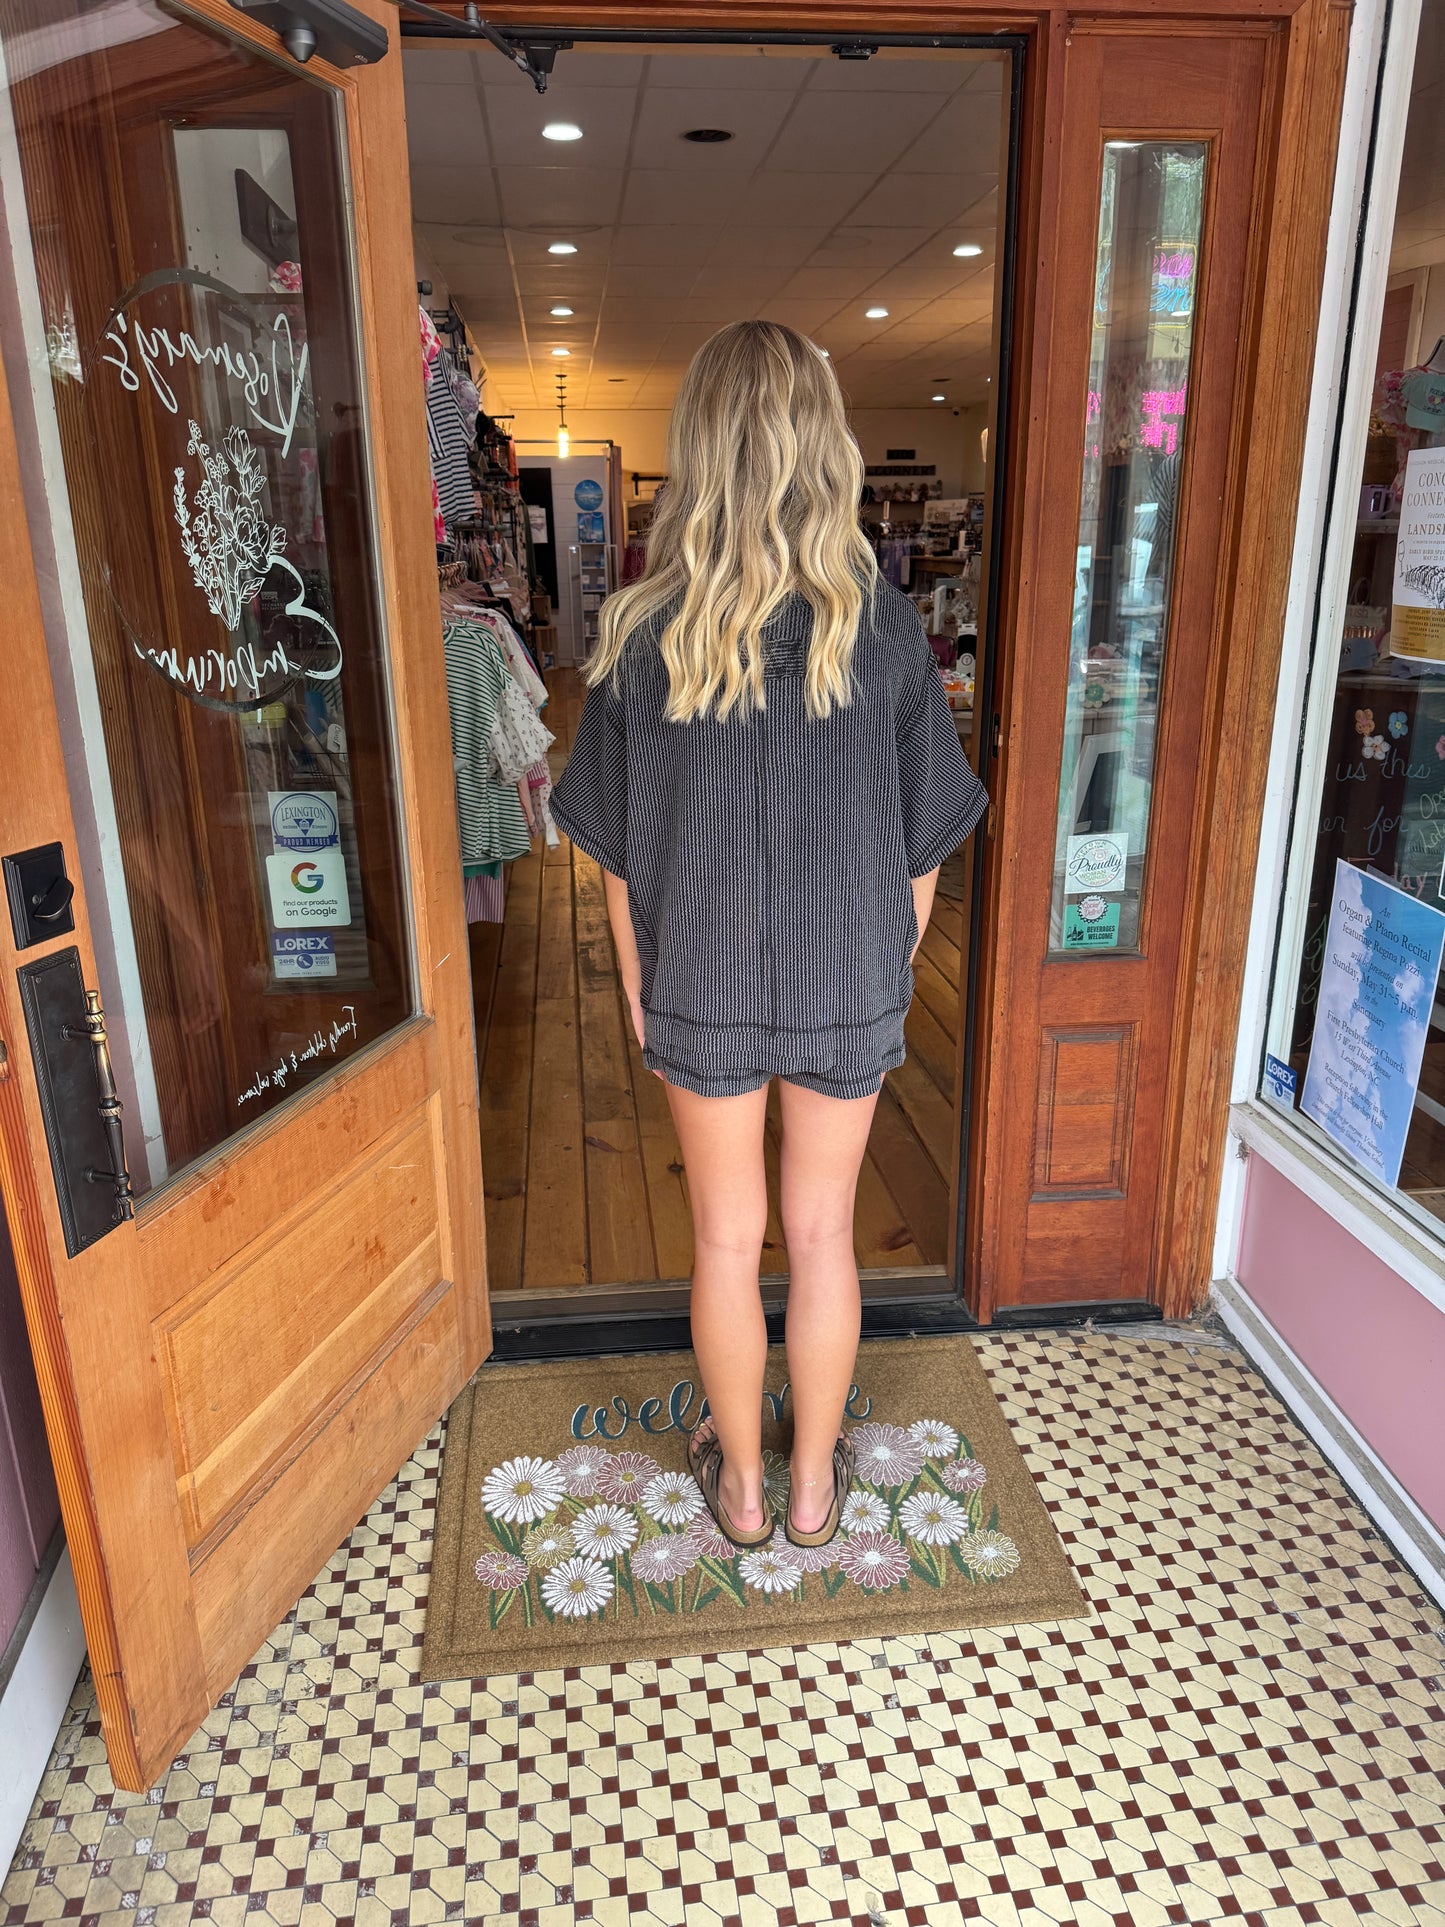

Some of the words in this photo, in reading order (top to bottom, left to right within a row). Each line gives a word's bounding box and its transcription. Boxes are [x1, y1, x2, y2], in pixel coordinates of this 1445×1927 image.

[1406, 491, 1445, 507] CONNE
[1407, 523, 1445, 536] LANDS
[1335, 761, 1368, 782] us
[1380, 747, 1432, 779] this
[281, 806, 326, 822] LEXINGTON
[1364, 805, 1409, 856] for
[283, 837, 304, 847] PROUD
[306, 837, 331, 846] MEMBER
[1068, 854, 1123, 877] Proudly
[282, 899, 296, 907] find
[308, 899, 338, 907] products
[285, 909, 299, 917] on
[300, 906, 338, 918] Google
[1086, 925, 1116, 934] BEVERAGES
[1087, 932, 1114, 940] WELCOME
[1339, 899, 1364, 922] Organ
[1364, 914, 1373, 929] &
[1375, 919, 1400, 944] Piano
[1401, 934, 1432, 963] Recital
[275, 937, 329, 952] LOREX
[1342, 921, 1373, 951] featuring
[1373, 940, 1399, 964] Regina
[1332, 953, 1360, 983] Sunday,
[1361, 971, 1378, 994] May
[1401, 1001, 1419, 1020] p.m.
[1352, 998, 1387, 1032] Sanctuary
[1327, 1009, 1341, 1028] First
[1341, 1020, 1379, 1055] Presbyterian
[1380, 1049, 1405, 1075] Church
[1356, 1046, 1374, 1065] Third
[1267, 1058, 1296, 1088] LOREX
